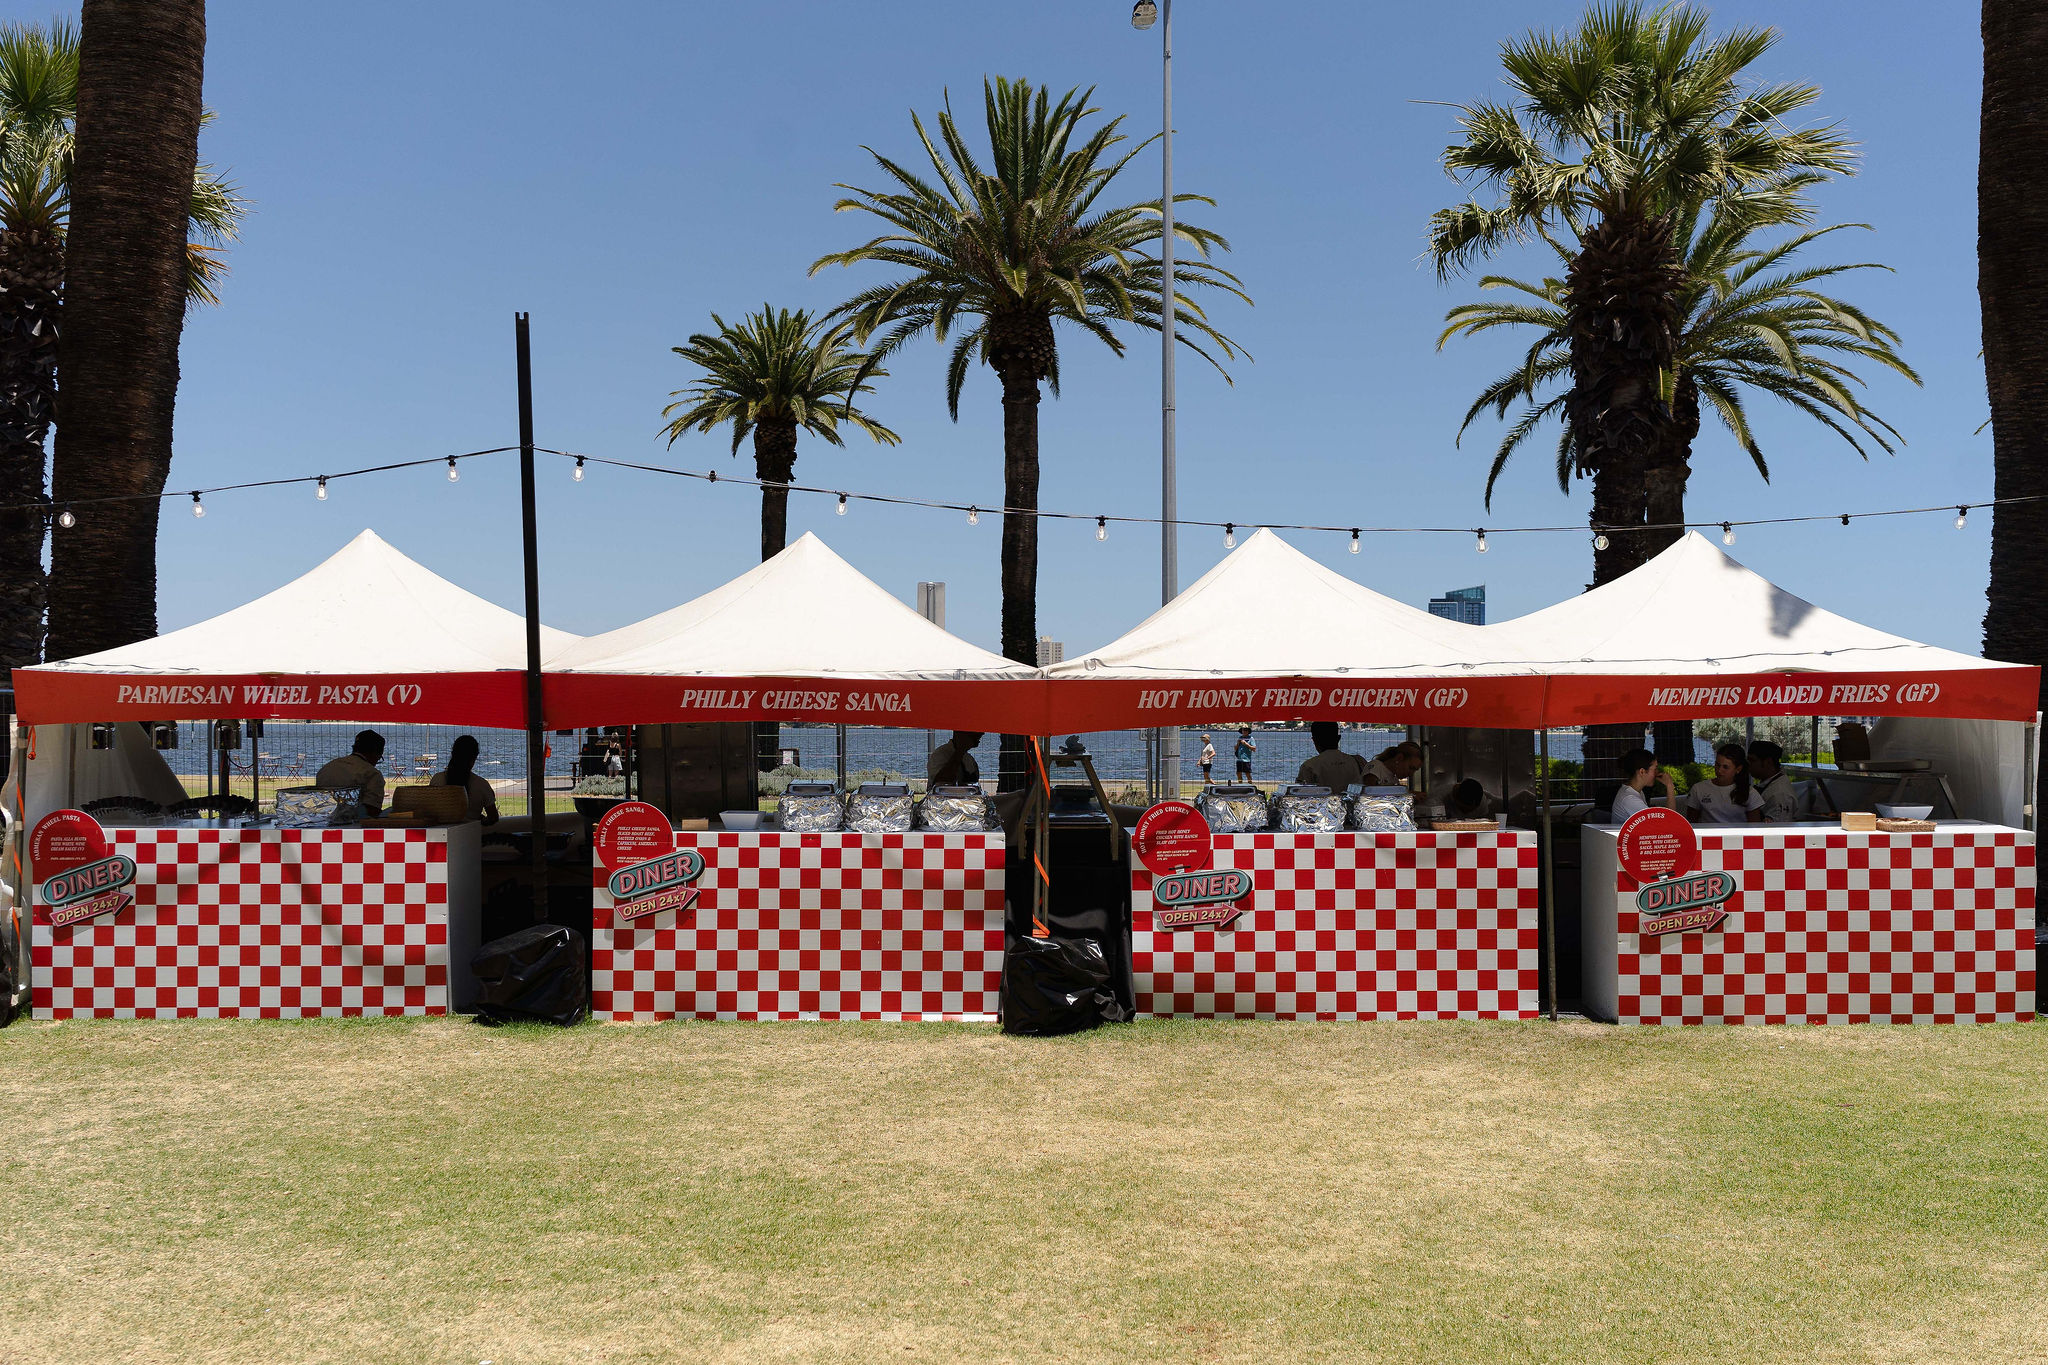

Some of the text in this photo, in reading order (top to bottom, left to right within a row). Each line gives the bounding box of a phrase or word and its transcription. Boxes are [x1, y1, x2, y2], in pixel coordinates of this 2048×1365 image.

[117, 684, 422, 706] PARMESAN WHEEL PASTA (V)
[681, 690, 912, 712] PHILLY CHEESE SANGA
[1138, 687, 1469, 709] HOT HONEY FRIED CHICKEN (GF)
[1648, 683, 1940, 706] MEMPHIS LOADED FRIES (GF)
[600, 827, 608, 848] PHILLY
[605, 808, 624, 826] CHEESE
[1140, 820, 1150, 840] HONEY
[1148, 808, 1164, 821] FRIED
[1165, 806, 1190, 815] CHICKEN
[34, 830, 44, 860] PARMESAN
[42, 816, 61, 830] WHEEL
[1622, 833, 1630, 860] MEMPHIS
[1627, 815, 1646, 833] LOADED
[51, 860, 124, 900] DINER
[619, 856, 692, 894] DINER
[1165, 874, 1240, 900] DINER
[623, 890, 687, 916] OPEN 24x7
[1647, 876, 1723, 908] DINER
[56, 896, 120, 922] OPEN 24x7
[1164, 909, 1230, 923] OPEN 24x7
[1649, 911, 1715, 932] OPEN 24x7
